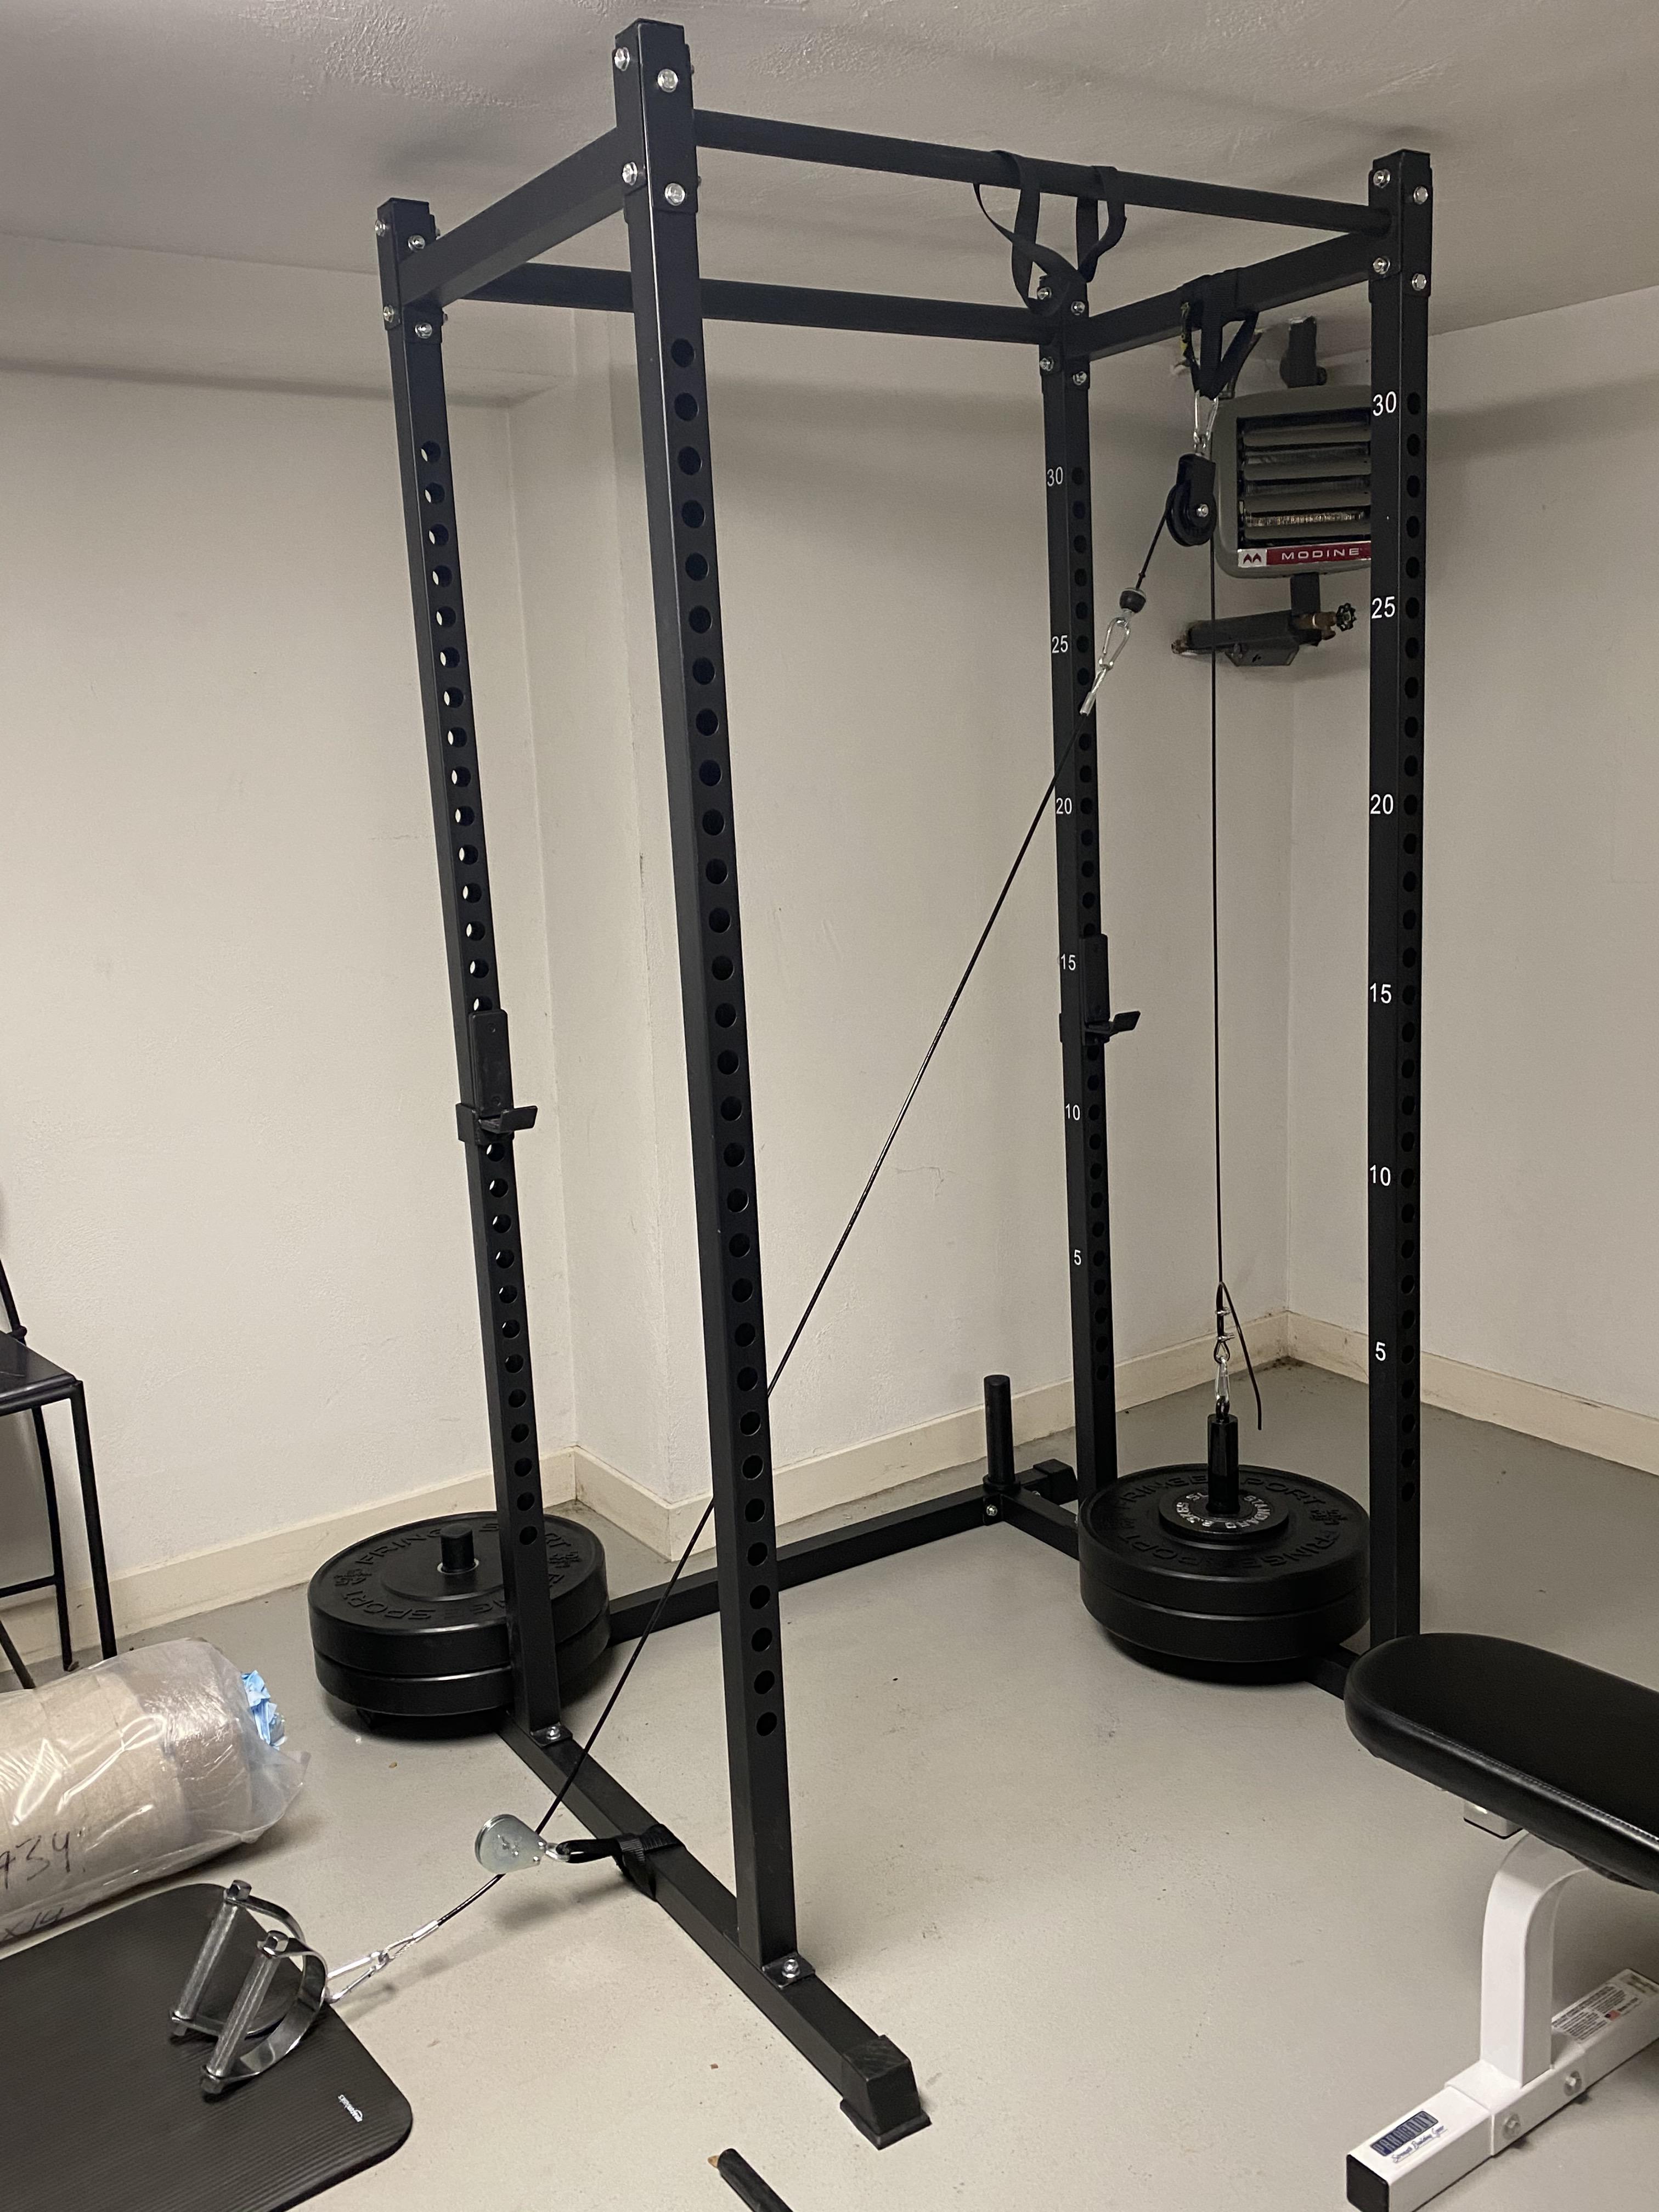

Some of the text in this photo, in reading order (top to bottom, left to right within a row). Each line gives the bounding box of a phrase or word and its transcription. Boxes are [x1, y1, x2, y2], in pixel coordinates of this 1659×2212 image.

[1372, 391, 1397, 417] 30
[1046, 466, 1064, 487] 30
[1281, 548, 1359, 560] MODINE
[1370, 595, 1396, 620] 25
[1051, 634, 1069, 654] 25
[1056, 797, 1073, 815] 20
[1369, 793, 1394, 815] 20
[1060, 953, 1076, 972] 15
[1369, 982, 1392, 1005] 15
[1065, 1103, 1081, 1121] 10
[1369, 1164, 1391, 1187] 10
[1073, 1249, 1082, 1266] 5
[1374, 1341, 1387, 1362] 5
[1241, 1477, 1327, 1505] PORT
[356, 1528, 442, 1565] FRING
[343, 1590, 436, 1620] SPORT
